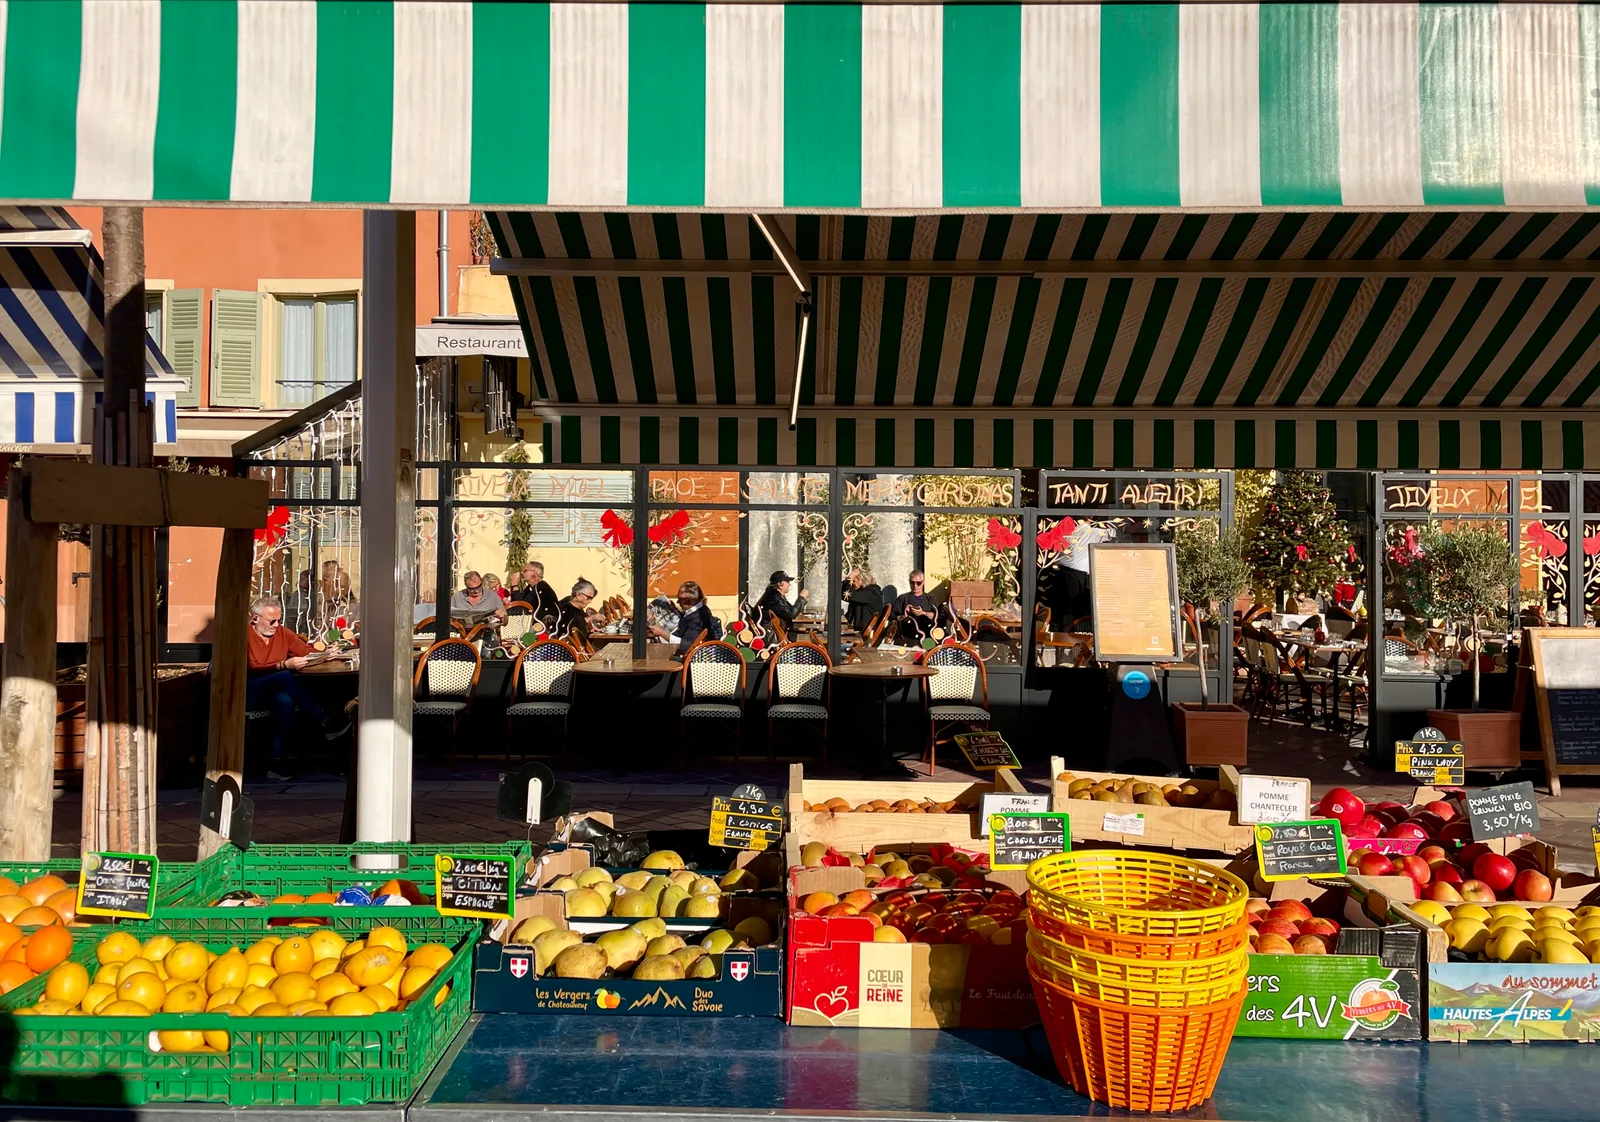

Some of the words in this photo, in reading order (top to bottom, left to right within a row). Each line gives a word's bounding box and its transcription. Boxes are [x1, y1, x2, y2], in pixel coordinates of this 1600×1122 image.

[437, 336, 522, 349] Restaurant
[652, 477, 707, 499] PACE
[719, 477, 737, 497] E
[845, 479, 918, 502] MERRY
[917, 482, 1013, 506] CHRISTMAS
[1048, 482, 1109, 505] TANTI
[1120, 483, 1203, 506] AUGURI
[1386, 485, 1480, 509] JOYEUX
[1483, 484, 1553, 510] NEL
[1420, 728, 1437, 738] 1Kg
[1396, 742, 1414, 753] Prix
[1419, 743, 1443, 755] 4,50
[1435, 758, 1459, 767] LADY
[1259, 792, 1289, 800] POMME
[1468, 795, 1499, 810] POMME
[1500, 792, 1522, 802] PIXIE
[713, 797, 731, 811] Prix
[1250, 802, 1298, 812] CHANTECLER
[1473, 804, 1506, 815] CRUNCH
[1514, 801, 1533, 812] BIO
[1277, 842, 1305, 856] Royal
[1309, 841, 1336, 852] Gala
[1279, 861, 1314, 871] France
[868, 969, 903, 983] CŒUR
[1502, 975, 1524, 989] au
[1530, 973, 1599, 989] sommet
[554, 988, 590, 1003] Vergers
[694, 986, 713, 998] Duo
[968, 988, 981, 999] Le
[987, 988, 1012, 999] Fruit
[1013, 989, 1025, 999] de
[538, 1000, 545, 1008] de
[692, 1000, 723, 1011] Savoie
[1351, 1006, 1376, 1016] VERGERS
[1386, 1001, 1397, 1010] 4V
[1246, 1005, 1275, 1021] des
[1281, 994, 1338, 1029] 4V
[1442, 1008, 1493, 1021] HAUTES
[1485, 989, 1552, 1038] ALPES
